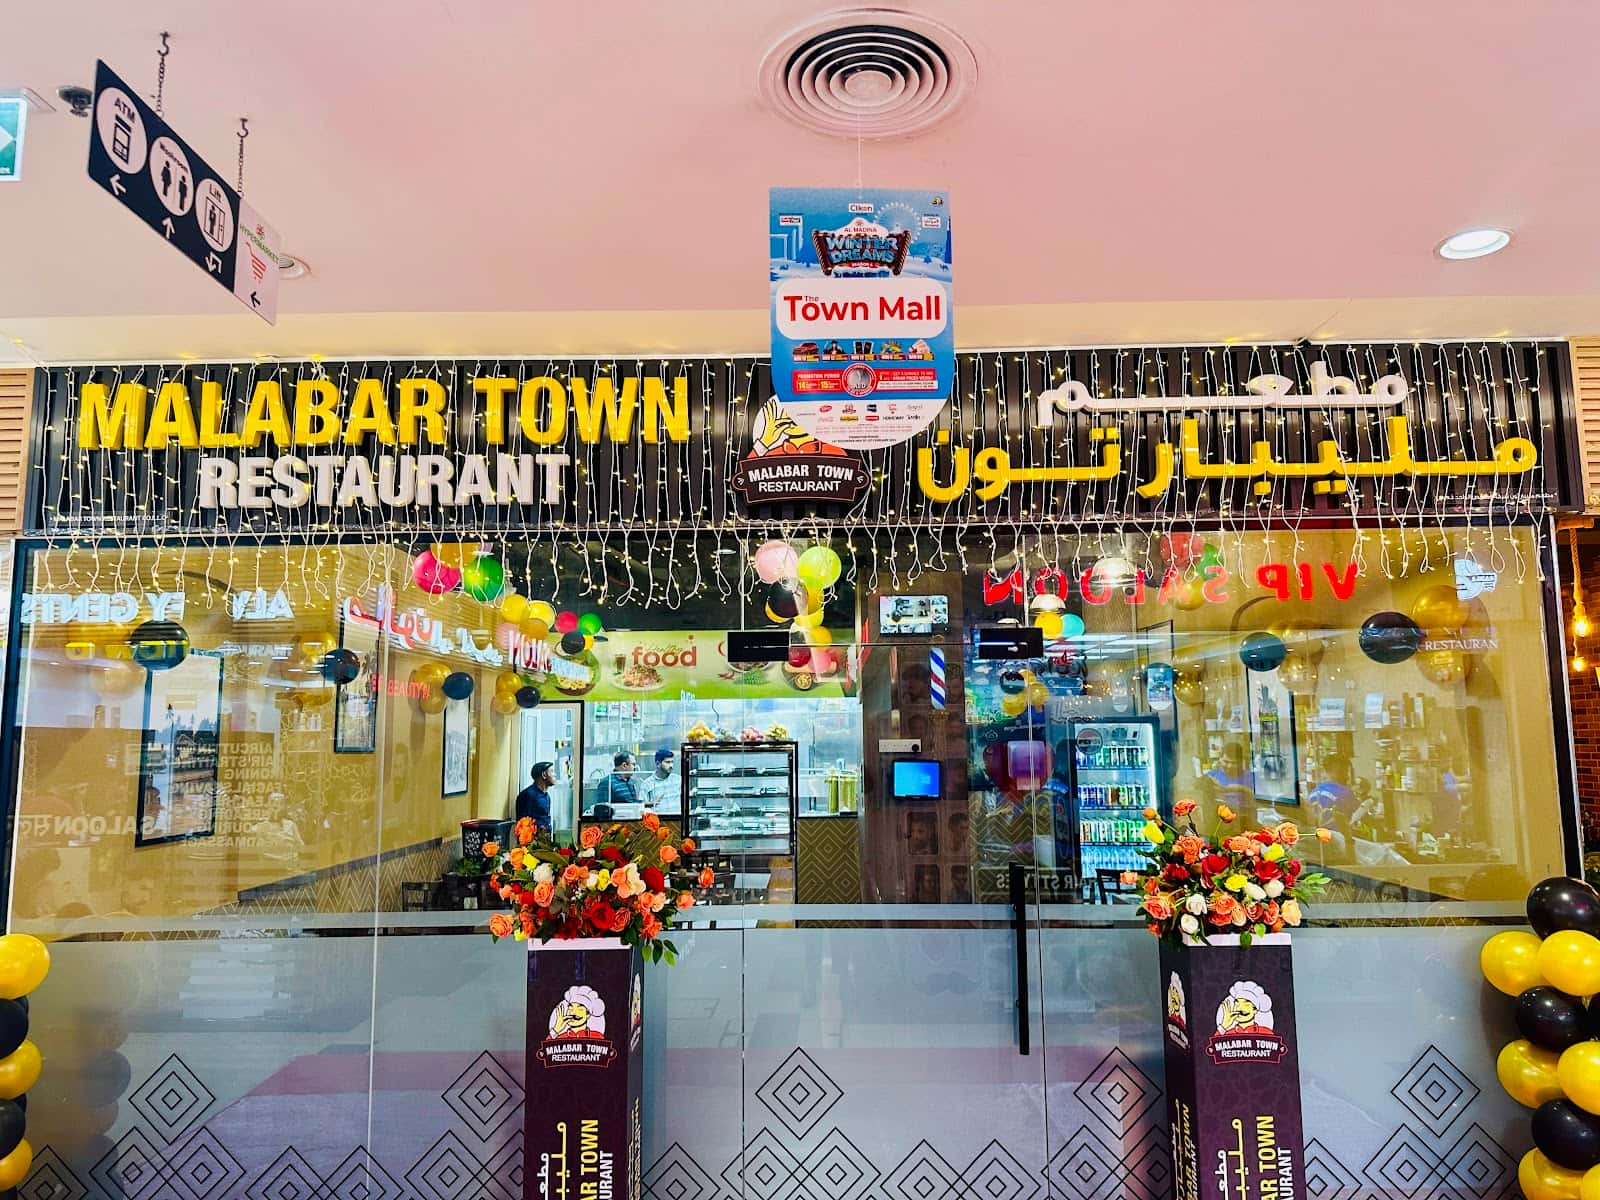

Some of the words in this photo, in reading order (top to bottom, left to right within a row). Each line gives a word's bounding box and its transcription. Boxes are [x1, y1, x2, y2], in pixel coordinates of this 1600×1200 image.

[114, 97, 136, 124] ATM
[826, 236, 898, 250] WINTER
[830, 249, 894, 263] DREAMS
[783, 296, 869, 321] Town
[879, 295, 940, 321] Mall
[1037, 360, 1409, 428] مطعم
[79, 378, 448, 450] MALABAR
[469, 376, 690, 446] TOWN
[198, 453, 571, 509] RESTAURANT
[748, 464, 809, 482] MALABAR
[817, 464, 853, 481] TOWN
[758, 480, 842, 493] RESTAURANT
[631, 645, 697, 668] food
[546, 1043, 583, 1055] MALABAR
[586, 1043, 609, 1055] TOWN
[1215, 1038, 1252, 1051] MALABAR
[1255, 1039, 1279, 1051] TOWN
[1221, 1049, 1272, 1059] RESTAURANT
[551, 1053, 602, 1062] RESTAURANT
[580, 1119, 599, 1176] TOWN
[1255, 1115, 1277, 1174] TOWN
